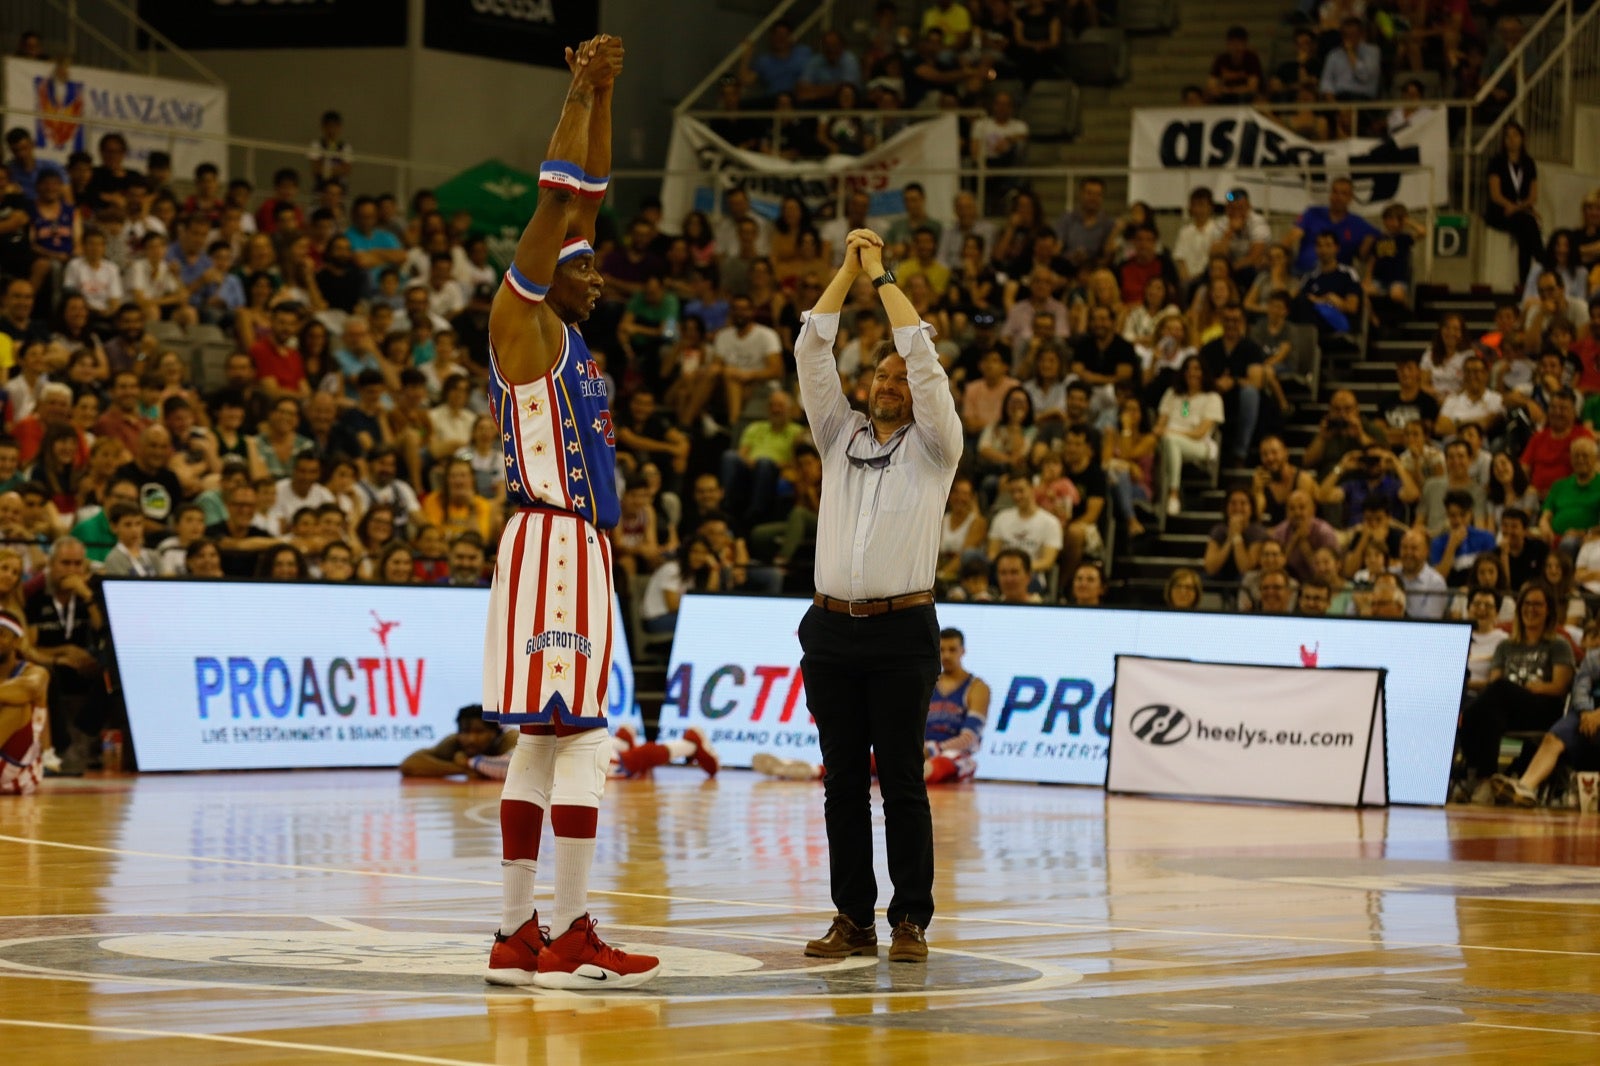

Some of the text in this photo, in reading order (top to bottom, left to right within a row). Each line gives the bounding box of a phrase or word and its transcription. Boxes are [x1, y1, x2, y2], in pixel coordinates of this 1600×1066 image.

[1437, 226, 1462, 257] D
[525, 630, 592, 659] GLOBETROTTERS
[195, 657, 425, 719] PROACTIV
[665, 663, 816, 723] ACTI
[201, 724, 437, 743] LIVE ENTERTAINMENT & BRAND EVENTS
[711, 728, 817, 747] BRAND EVEN
[1196, 720, 1354, 750] heelys.eu.com
[990, 740, 1029, 758] LIVE
